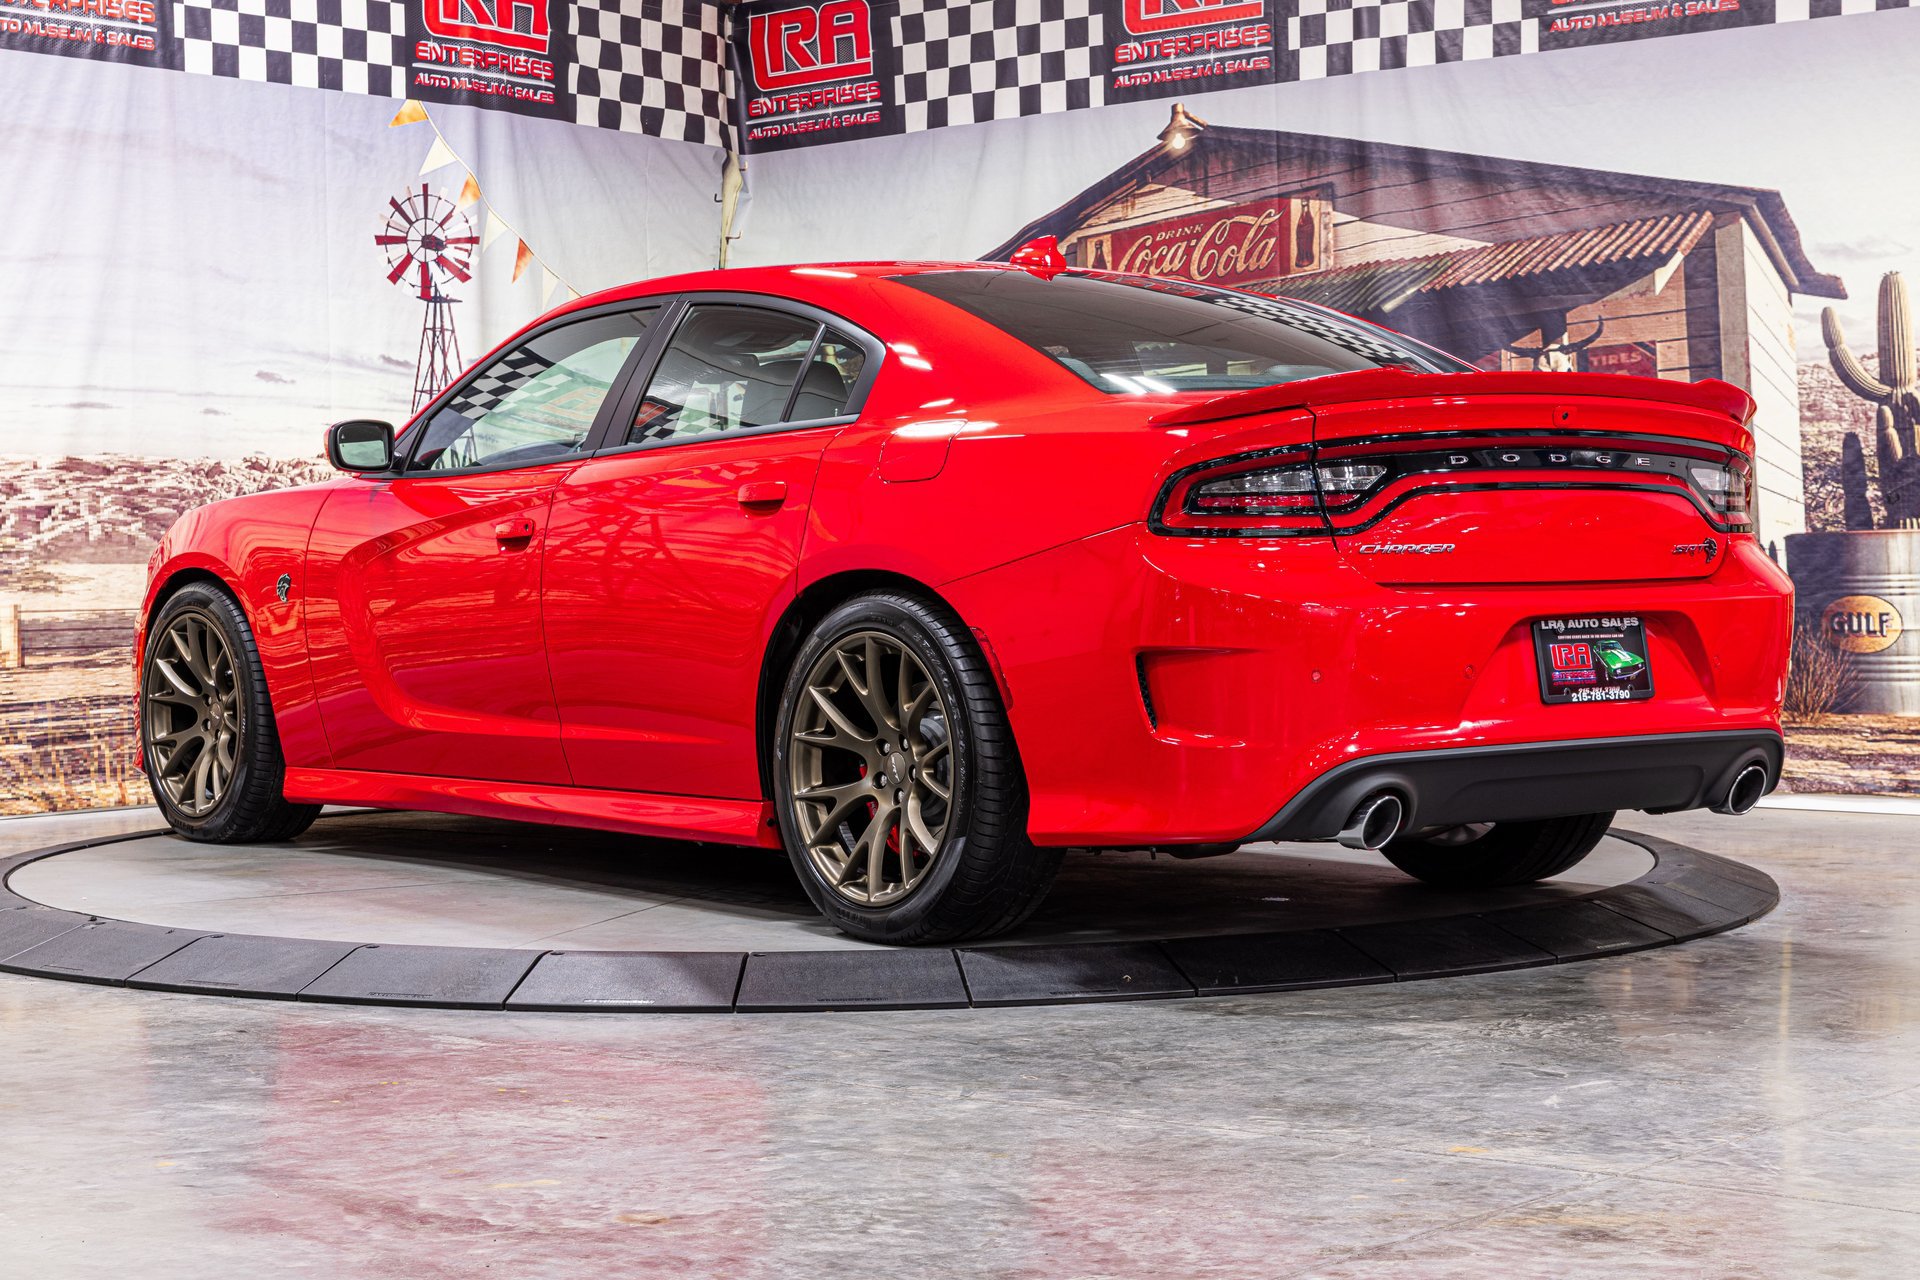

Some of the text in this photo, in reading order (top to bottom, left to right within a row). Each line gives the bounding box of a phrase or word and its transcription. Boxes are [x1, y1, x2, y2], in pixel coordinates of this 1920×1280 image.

[1549, 0, 1740, 33] AUTO MUSEUM & SALES
[0, 17, 155, 51] TO MUSEUM & SALES
[748, 0, 874, 92] LRA
[1115, 23, 1272, 63] ENTERPRISES
[415, 40, 556, 81] ENTERPRISES
[1113, 56, 1271, 89] AUTO MUSEUM & SALES
[414, 72, 555, 105] AUTO MUSEUM & SALES
[748, 81, 881, 118] ENTERPRISES
[748, 110, 881, 141] AUTO MUSEUM & SALES
[1117, 207, 1287, 282] Coca-Cola
[1155, 222, 1205, 243] DRINK
[1590, 351, 1642, 367] TIRES
[1450, 453, 1651, 466] DODGE
[1359, 543, 1456, 555] CHARGER
[1541, 617, 1639, 630] LRA AUTO SALES
[1830, 611, 1893, 638] GULF
[1550, 643, 1592, 670] LRA
[1572, 690, 1630, 701] 215-781-3790
